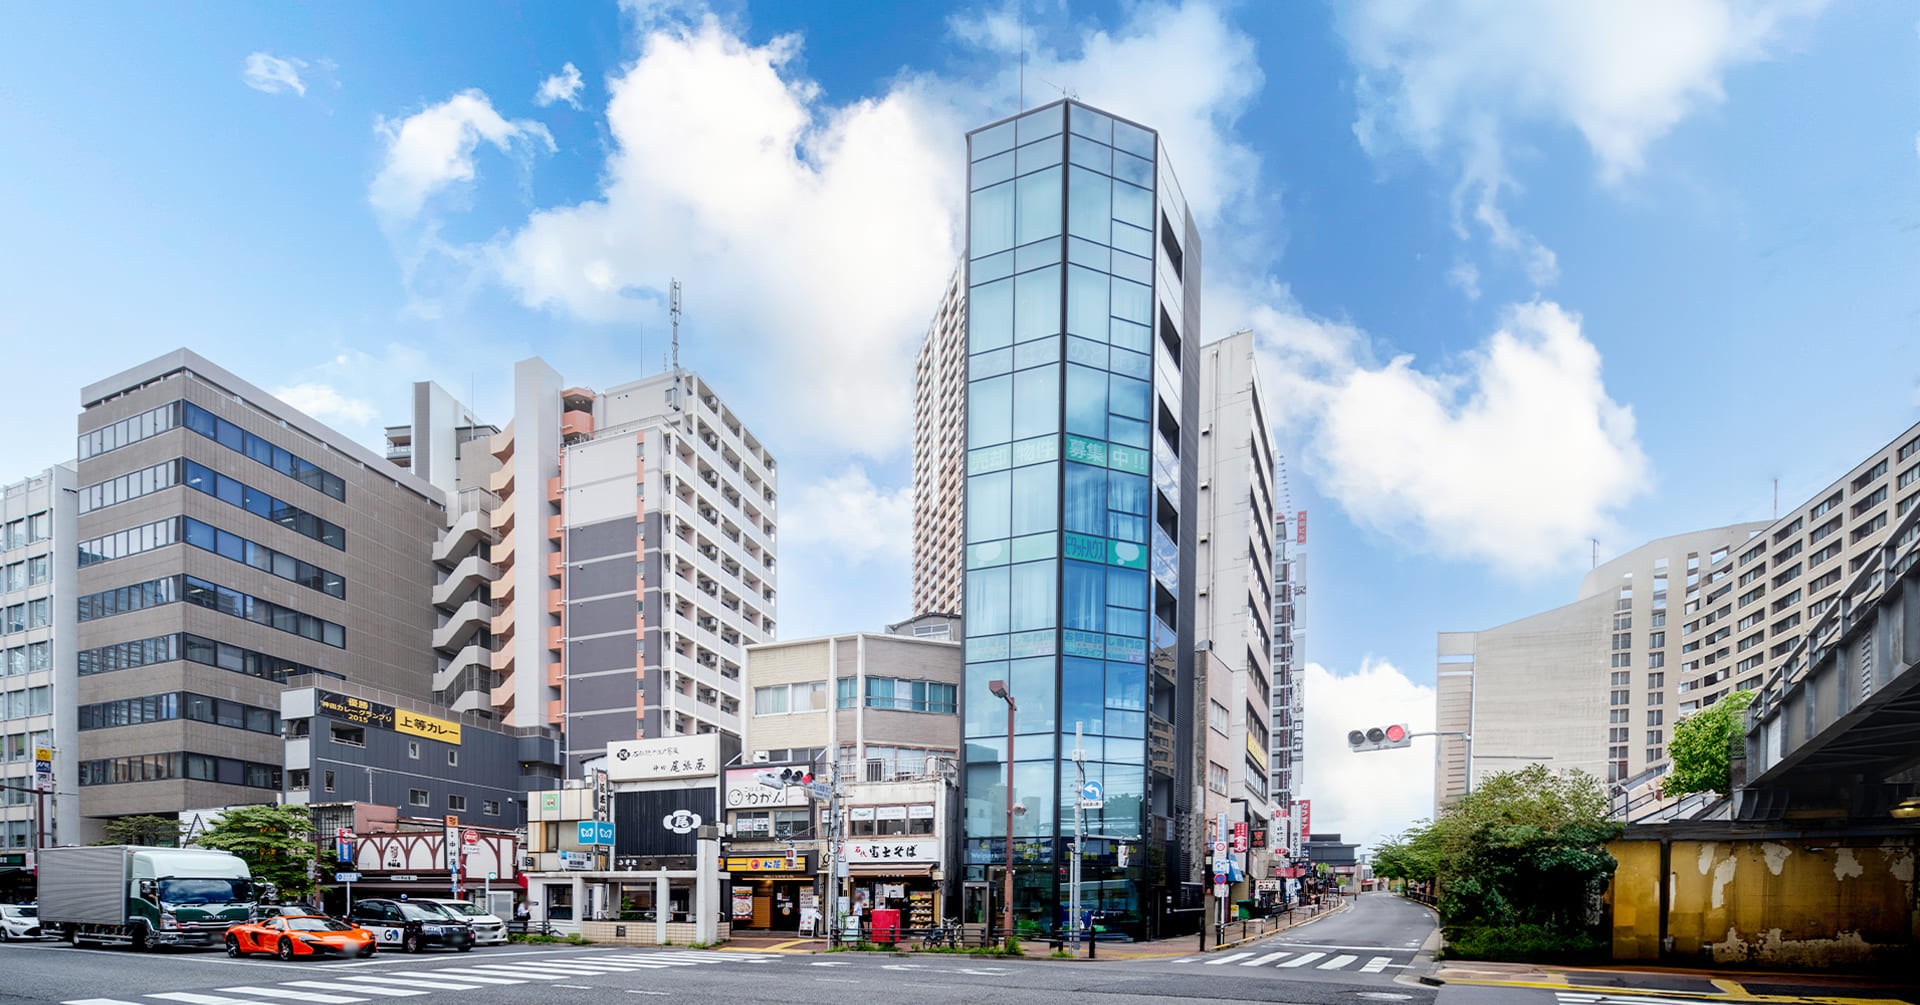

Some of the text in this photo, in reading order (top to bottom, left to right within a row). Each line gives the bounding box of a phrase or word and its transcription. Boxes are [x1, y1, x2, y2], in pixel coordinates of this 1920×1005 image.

[971, 440, 1055, 472] 売却物件
[1065, 535, 1105, 561] ピタットハウス
[347, 697, 369, 710] 優勝
[348, 712, 369, 723] 2015
[400, 716, 459, 736] 上等カレー
[869, 844, 918, 858] 富士そば
[763, 859, 782, 869] 松屋
